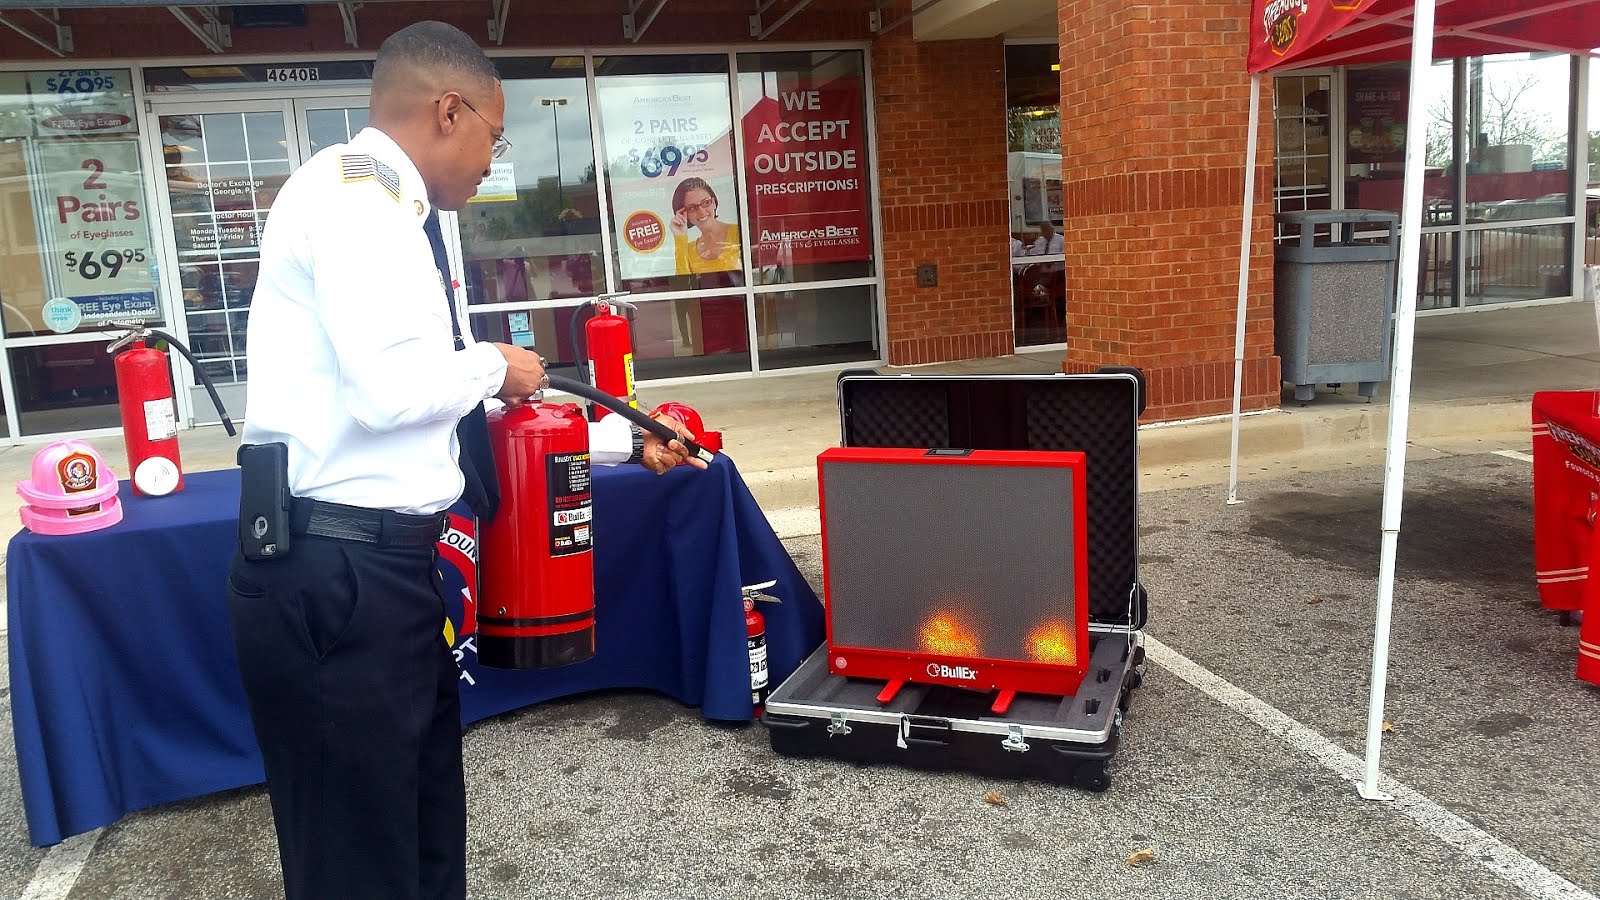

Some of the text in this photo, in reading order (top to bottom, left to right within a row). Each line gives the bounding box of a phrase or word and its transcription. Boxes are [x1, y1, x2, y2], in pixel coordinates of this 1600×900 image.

[269, 68, 318, 81] 4640B
[781, 91, 821, 111] WE
[80, 119, 95, 128] Eye
[97, 118, 122, 126] Exam
[633, 117, 698, 135] 2 PAIRS
[757, 119, 850, 143] ACCEPT
[753, 150, 857, 174] OUTSIDE
[81, 158, 107, 190] 2
[755, 178, 859, 195] PRESCRIPTIONS!
[56, 193, 141, 224] Pairs
[212, 212, 235, 220] octor
[70, 229, 134, 241] of Eyeglasses
[628, 223, 661, 240] FREE
[77, 300, 152, 312] REE Eye Exam
[84, 309, 156, 319] Independent Doctor
[440, 533, 476, 559] OUN
[941, 664, 977, 681] BullEx
